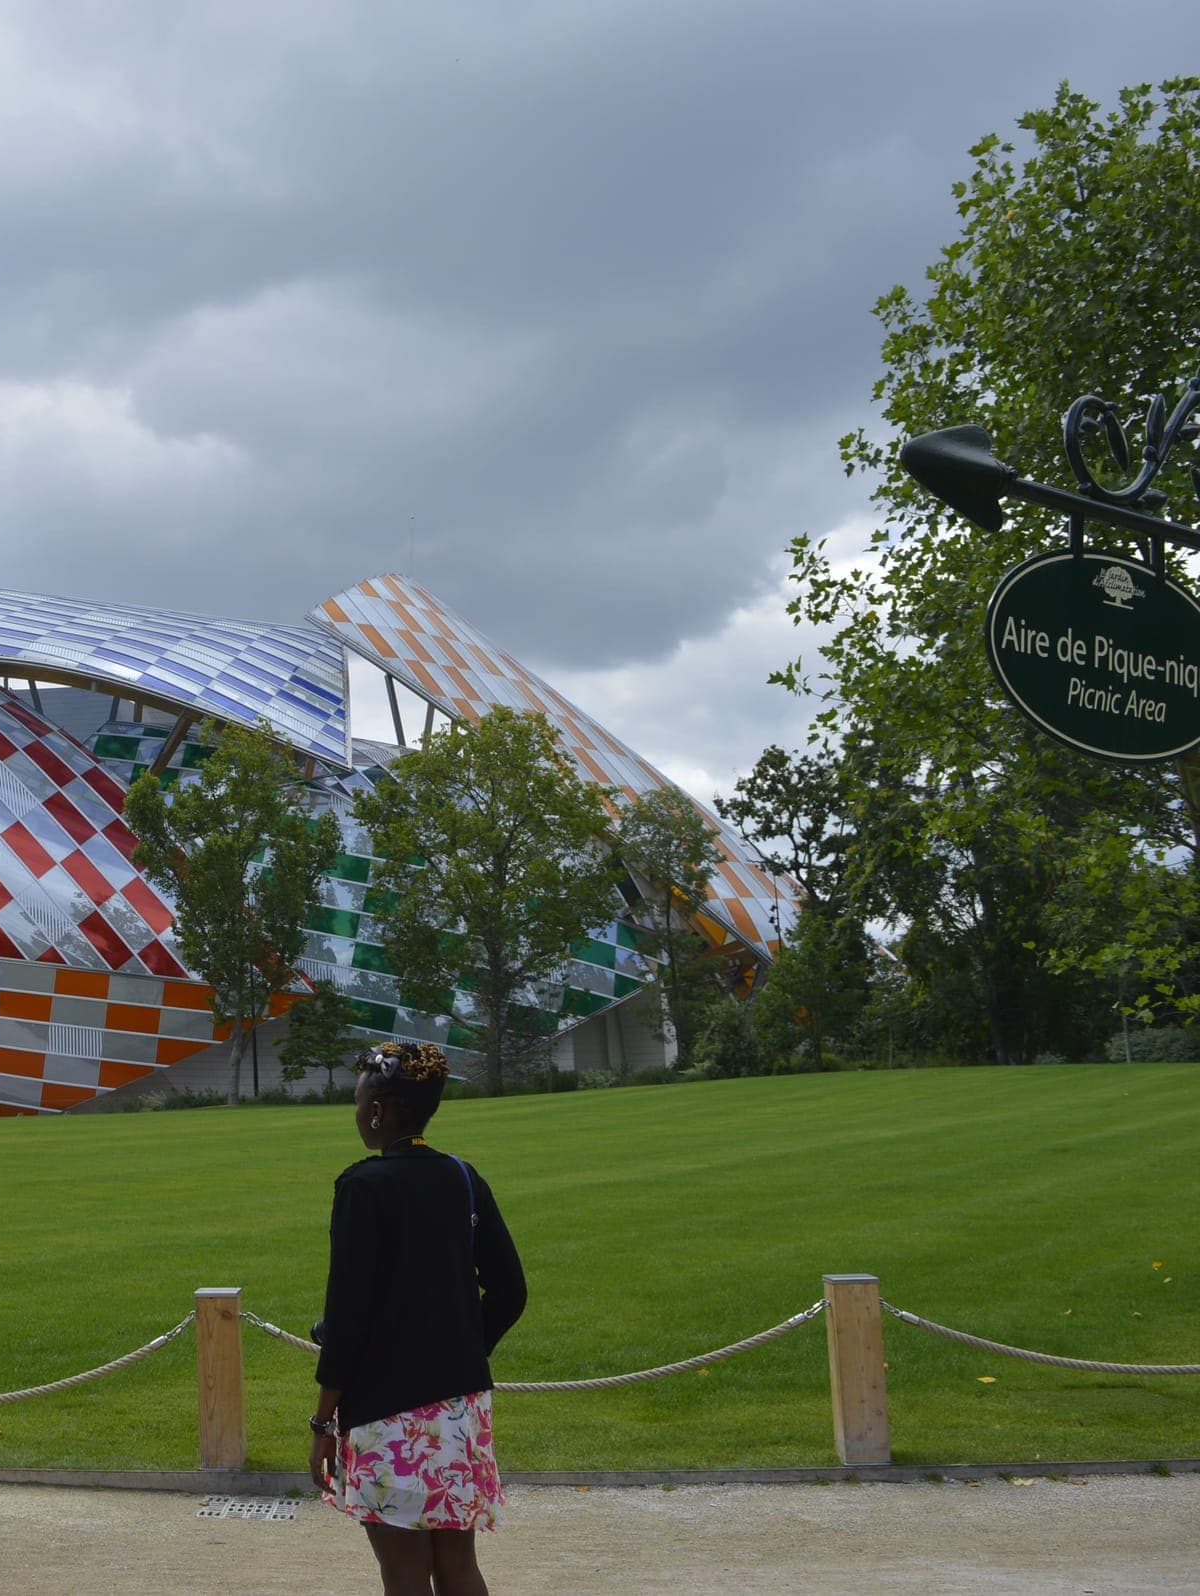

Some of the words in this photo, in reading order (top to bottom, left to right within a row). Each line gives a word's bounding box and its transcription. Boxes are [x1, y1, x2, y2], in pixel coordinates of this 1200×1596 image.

[1001, 616, 1050, 658] Aire
[1057, 627, 1087, 666] de
[1094, 635, 1200, 699] Pique-niq
[1067, 677, 1122, 714] Picnic
[1124, 689, 1167, 724] Area
